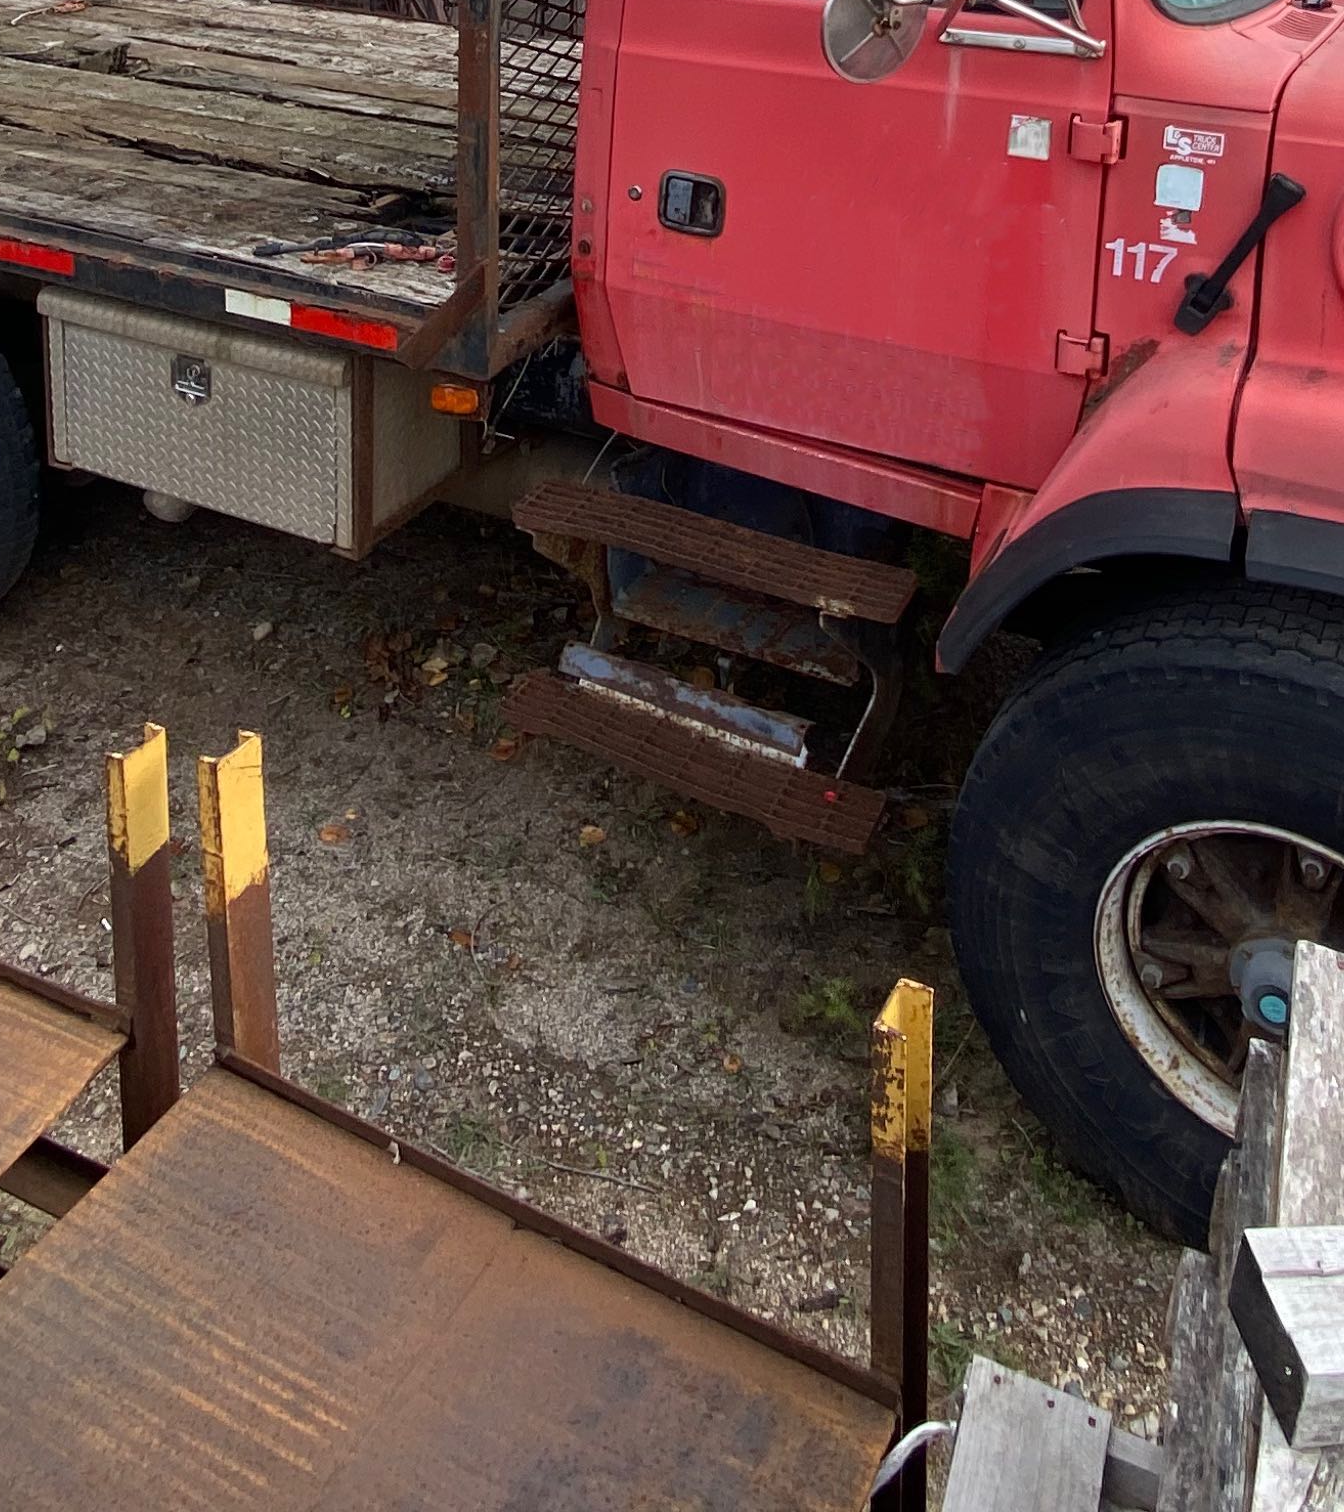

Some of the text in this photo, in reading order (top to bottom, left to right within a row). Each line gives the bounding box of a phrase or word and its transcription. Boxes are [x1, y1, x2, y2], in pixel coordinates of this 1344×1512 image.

[1193, 134, 1217, 144] TRUCK
[1192, 142, 1220, 153] CENTER
[1104, 238, 1178, 284] 117
